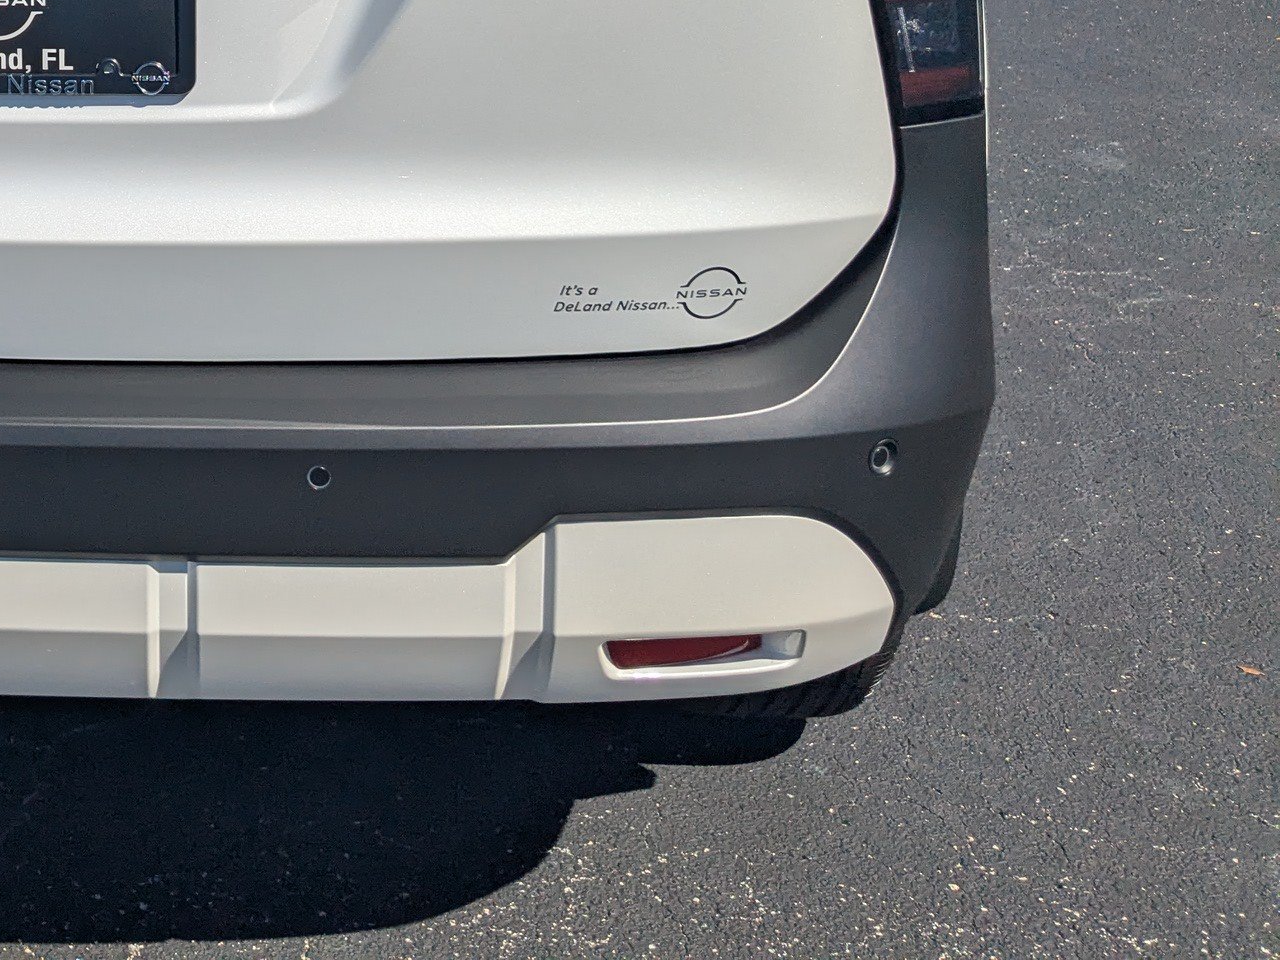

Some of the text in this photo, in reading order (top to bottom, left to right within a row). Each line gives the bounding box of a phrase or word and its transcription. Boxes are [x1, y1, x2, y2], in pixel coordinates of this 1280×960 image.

[42, 48, 74, 71] FL
[7, 73, 95, 96] Nissan
[131, 74, 170, 82] NISSAN
[559, 285, 598, 296] It's a
[676, 287, 747, 299] NISSAN
[553, 299, 680, 313] DeLand Nissan...
